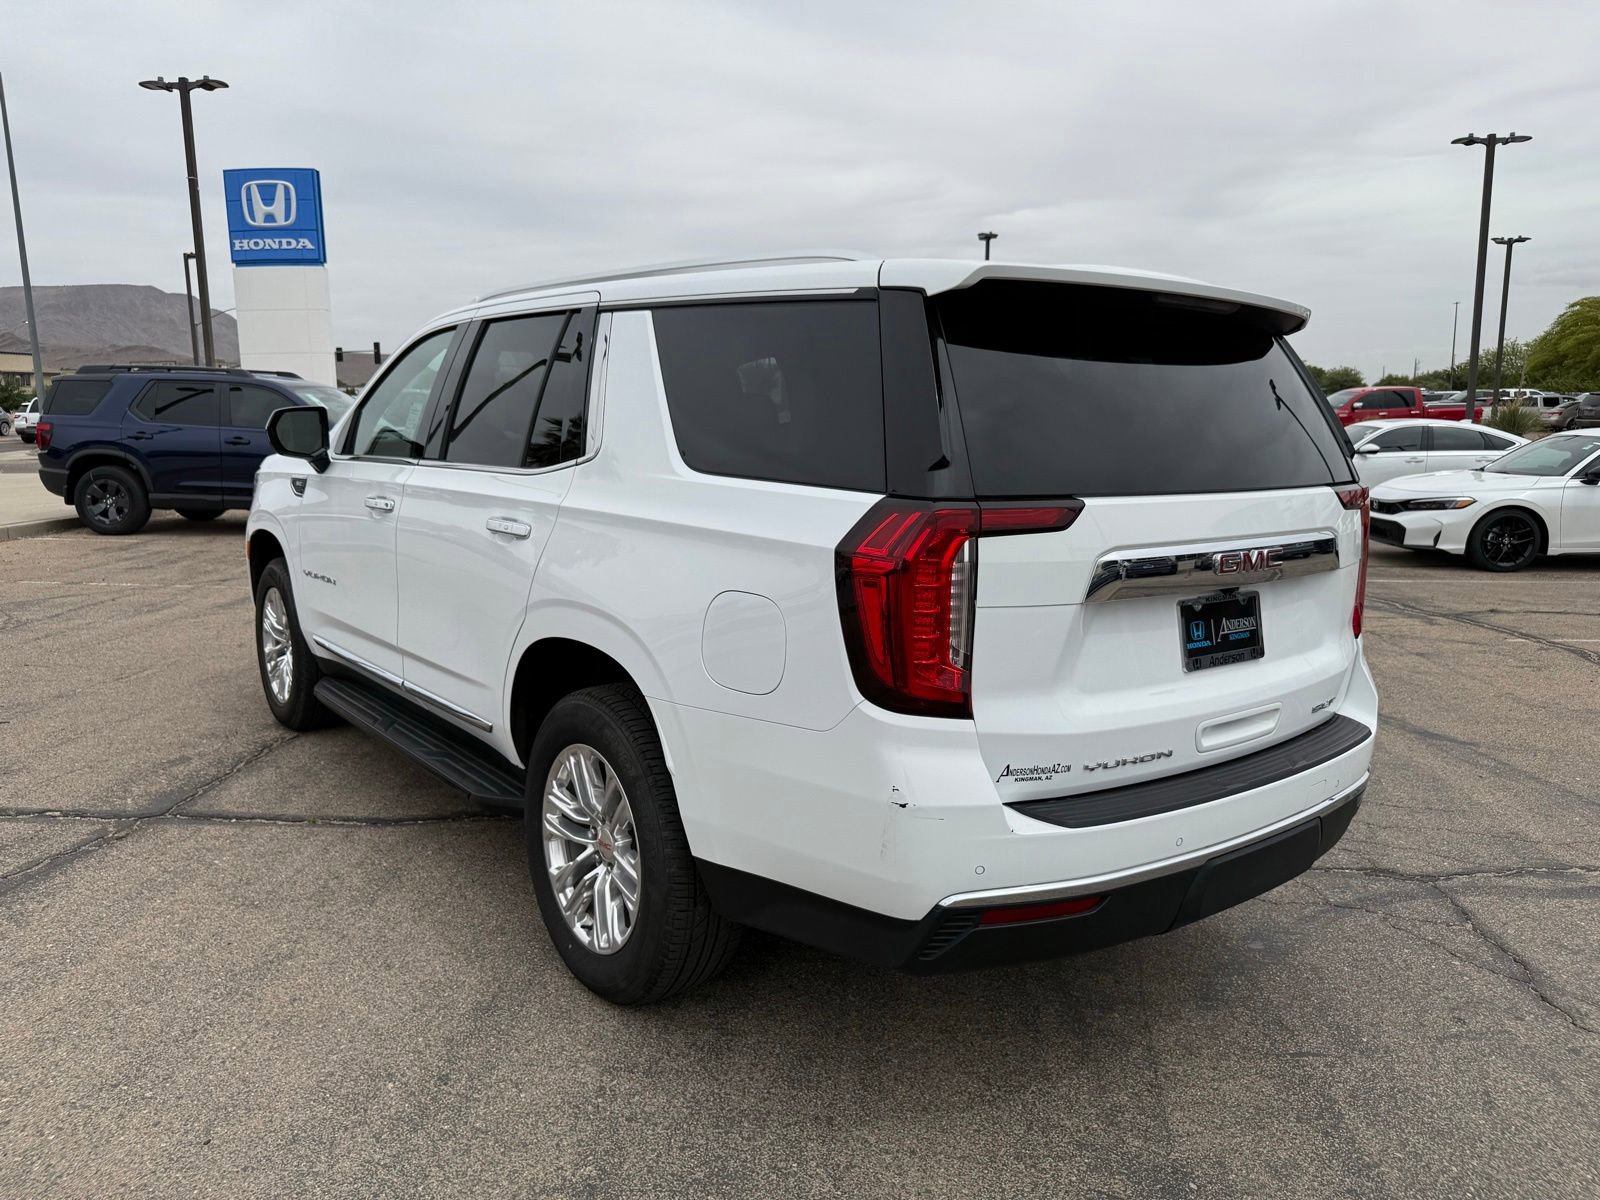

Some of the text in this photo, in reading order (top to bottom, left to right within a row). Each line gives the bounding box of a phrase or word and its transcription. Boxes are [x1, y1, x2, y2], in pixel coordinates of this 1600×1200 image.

[232, 238, 315, 250] HONDA
[1213, 547, 1283, 575] GMC
[1217, 616, 1257, 642] ANDERSON
[1186, 640, 1212, 649] HONDA
[1209, 652, 1245, 666] Anderson
[1083, 749, 1173, 771] YUKON
